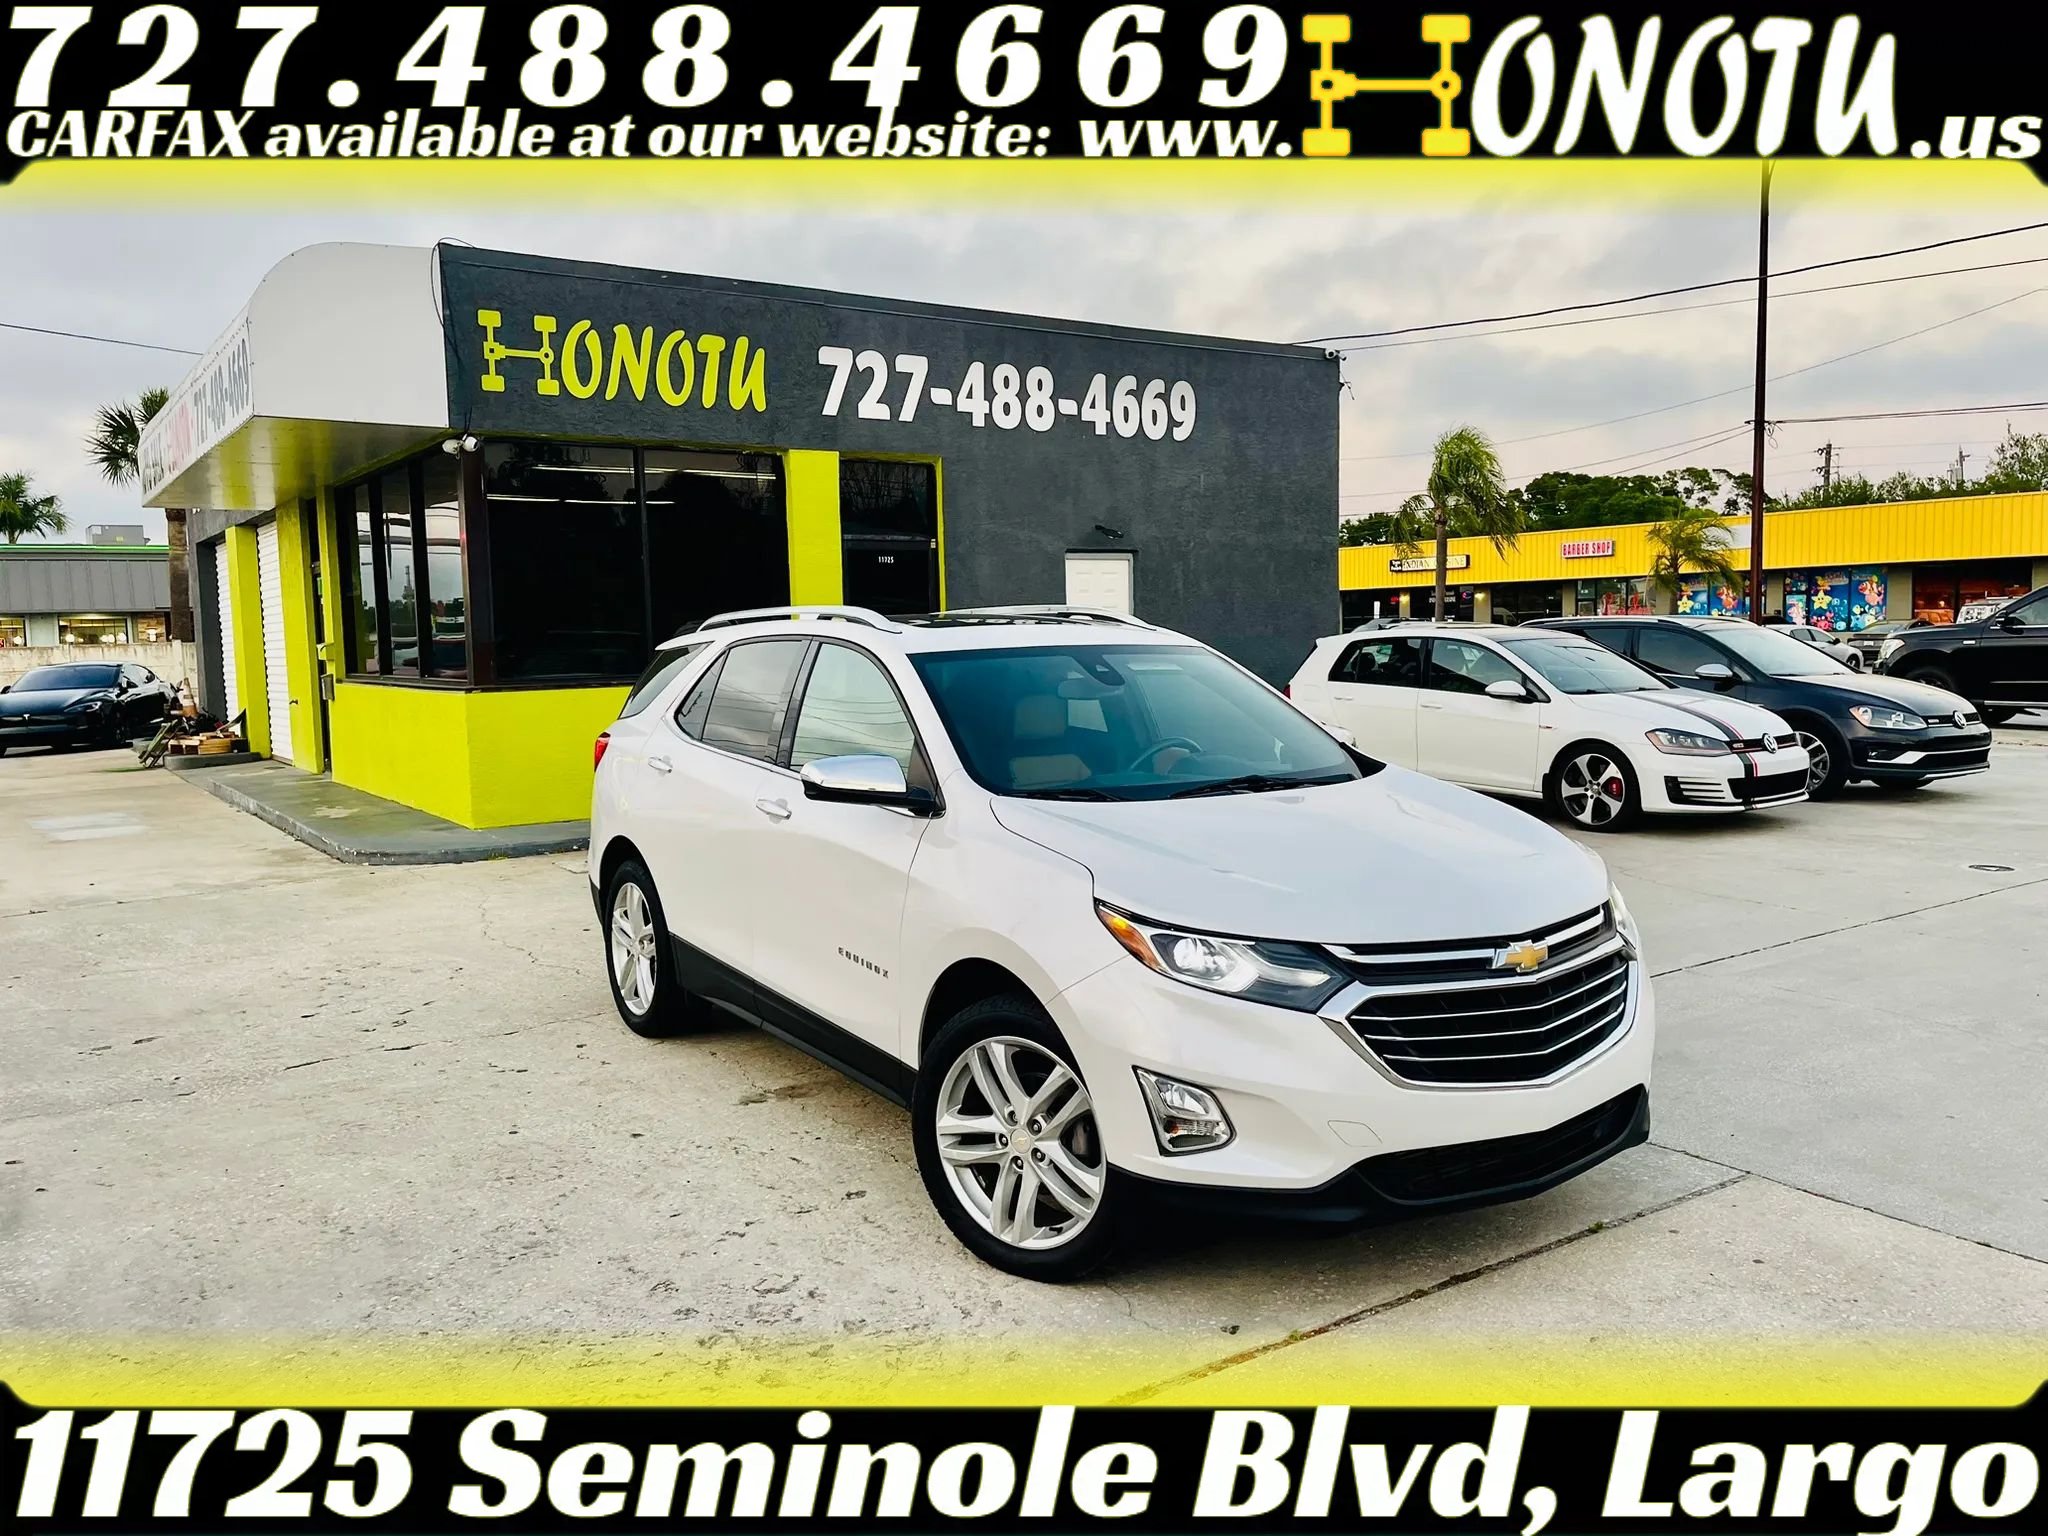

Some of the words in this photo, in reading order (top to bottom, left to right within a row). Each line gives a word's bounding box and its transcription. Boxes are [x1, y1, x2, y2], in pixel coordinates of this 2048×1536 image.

[818, 345, 1198, 442] 727-488-4669
[1563, 543, 1590, 556] BARBER
[1592, 541, 1611, 554] SHOP
[878, 556, 894, 564] 11725
[1403, 559, 1430, 570] INDIAN
